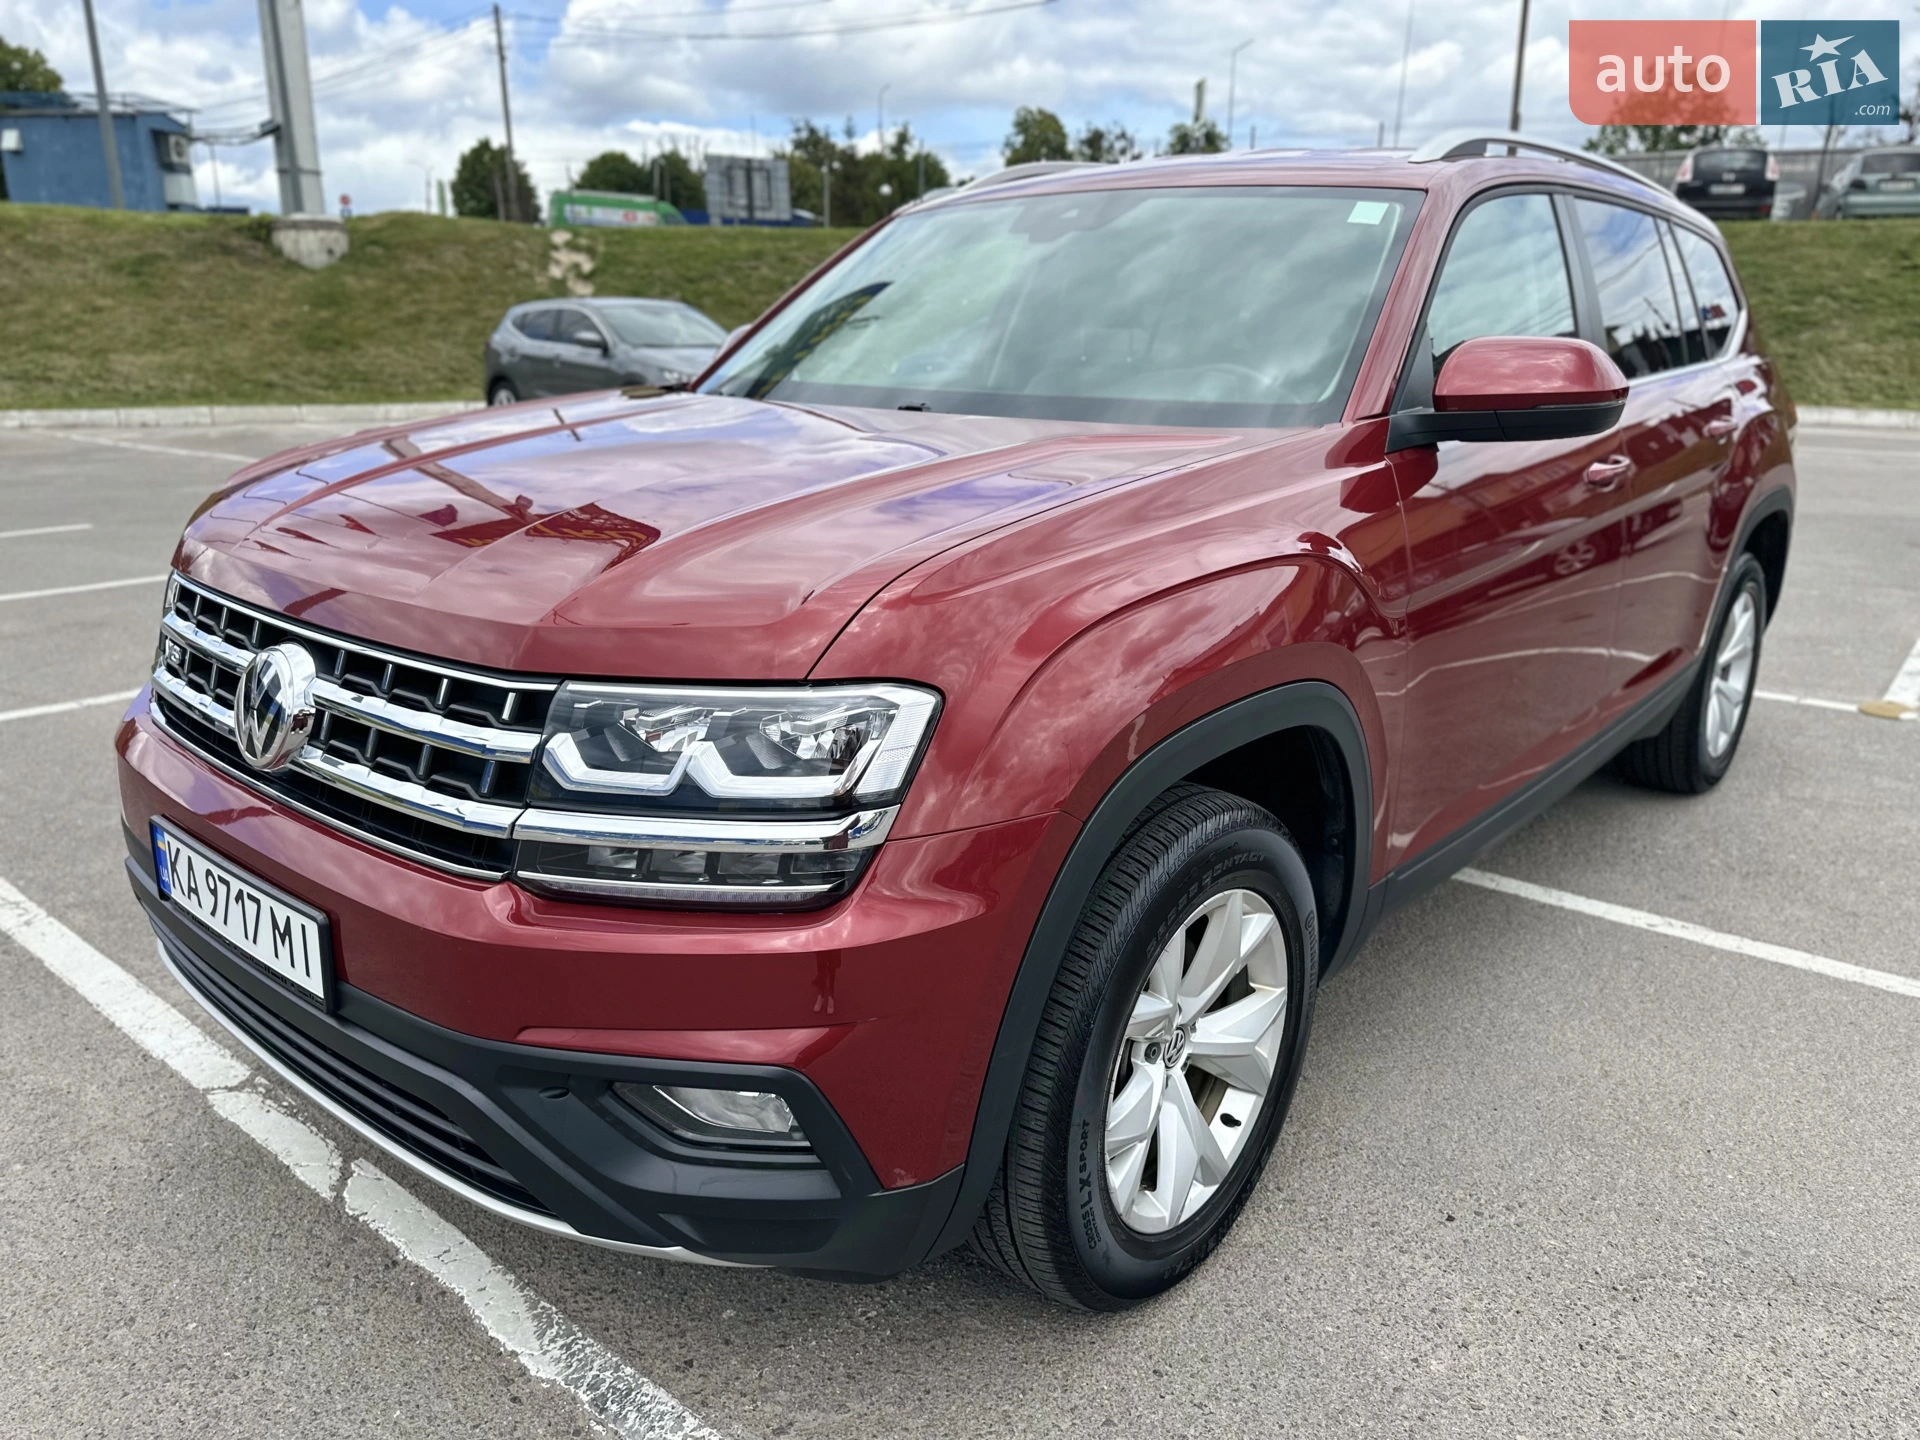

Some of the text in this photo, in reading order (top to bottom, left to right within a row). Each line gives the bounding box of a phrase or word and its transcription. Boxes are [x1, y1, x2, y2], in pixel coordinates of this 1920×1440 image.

[167, 840, 311, 978] KA 9717 MI
[1079, 1119, 1097, 1250] CROSS LX SPORT
[1089, 1206, 1102, 1243] CONTACT
